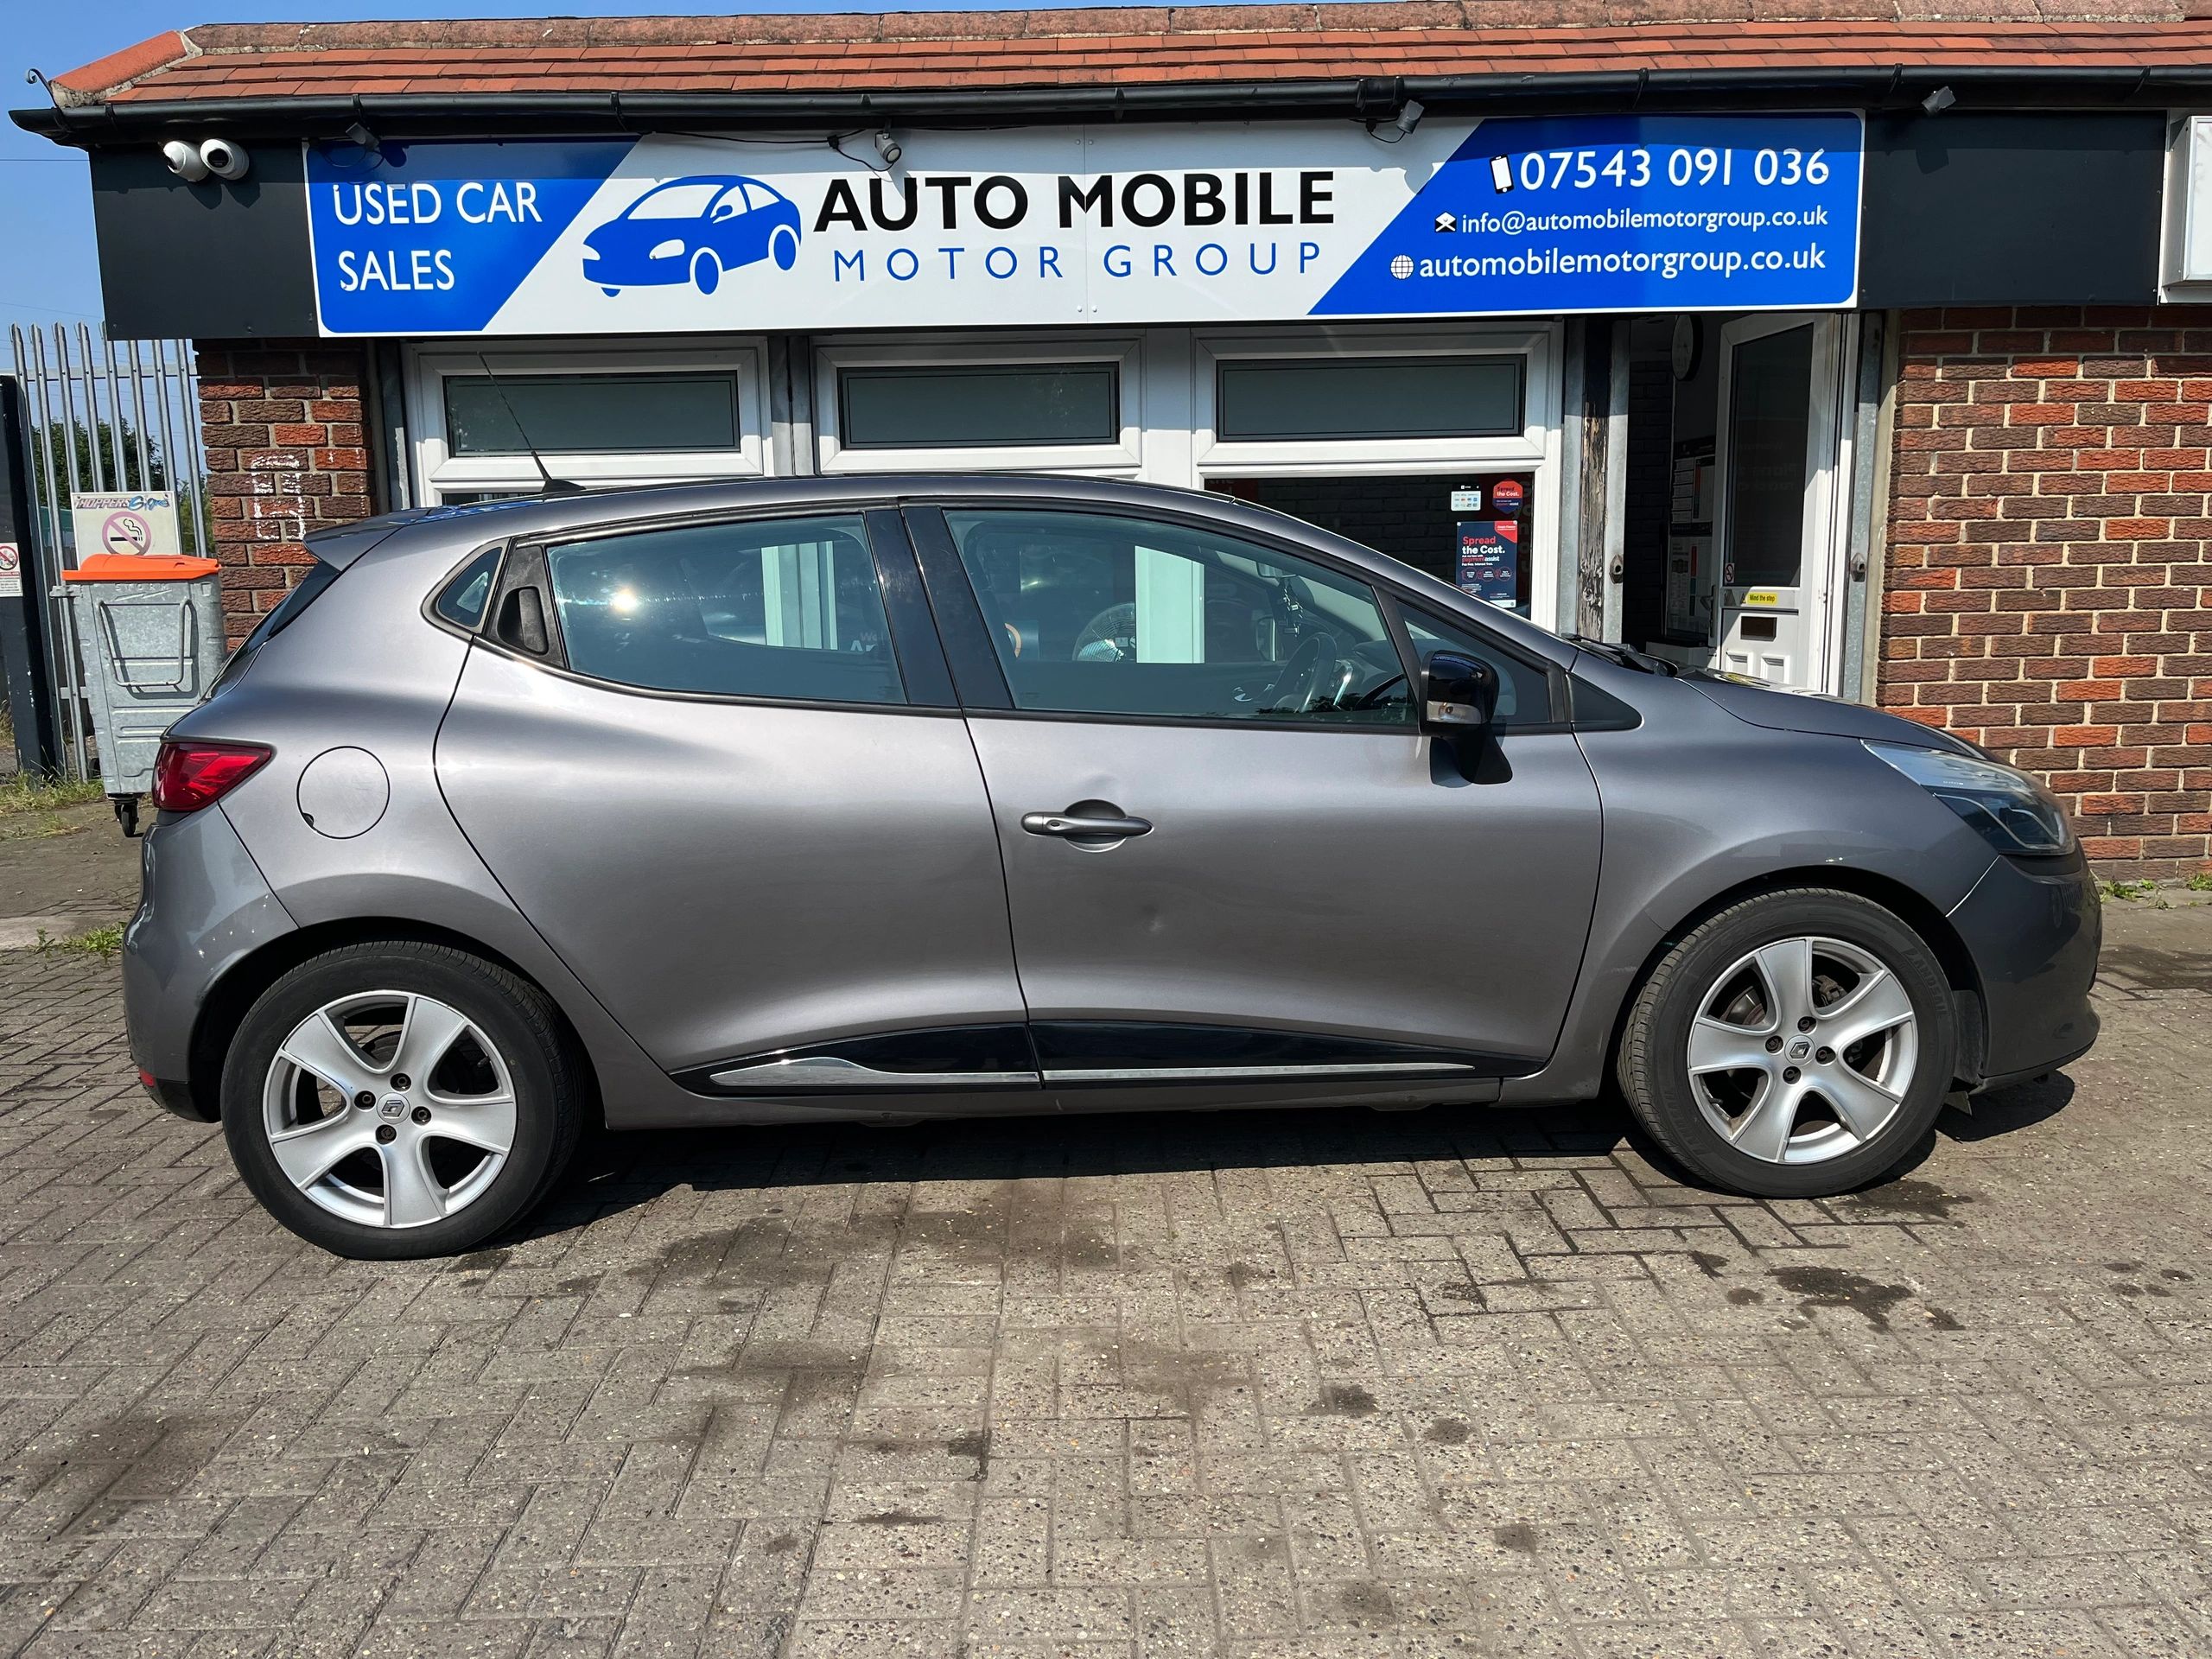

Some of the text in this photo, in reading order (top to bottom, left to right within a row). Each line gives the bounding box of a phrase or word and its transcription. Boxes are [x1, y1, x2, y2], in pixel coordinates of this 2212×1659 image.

[1520, 147, 1829, 190] 07543 091 036
[334, 181, 543, 226] USED CAR
[814, 171, 1335, 232] AUTO MOBILE
[1462, 205, 1828, 235] info@automobilemotorgroup.co.uk
[339, 249, 455, 292] SALES
[834, 242, 1321, 283] MOTOR GROUP
[1420, 242, 1826, 279] automobilemotorgroup.co.uk
[1462, 544, 1506, 555] the Cost.
[1463, 536, 1497, 546] Spread
[1766, 594, 1776, 604] step
